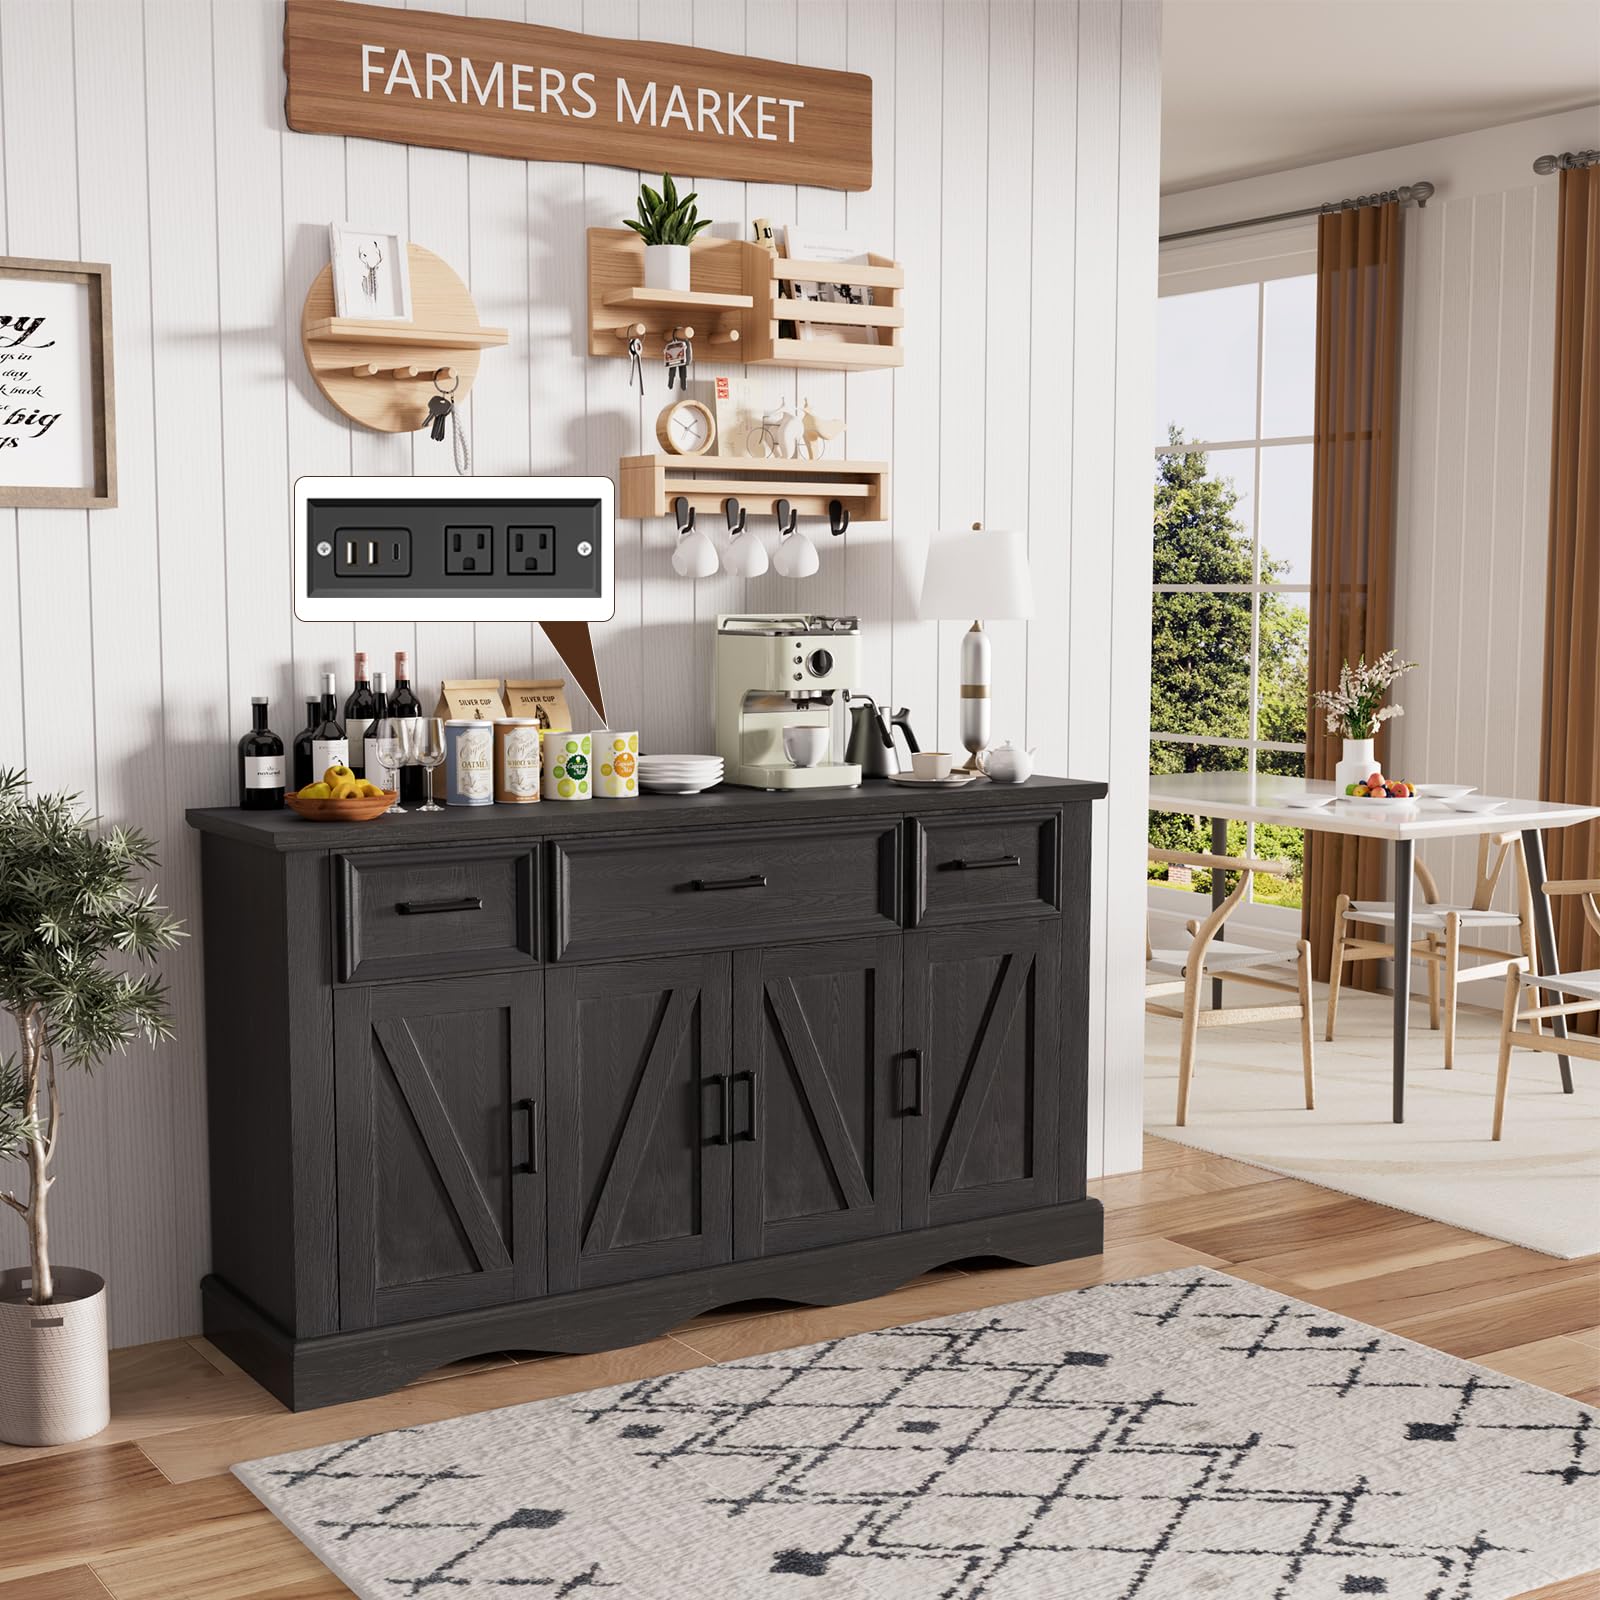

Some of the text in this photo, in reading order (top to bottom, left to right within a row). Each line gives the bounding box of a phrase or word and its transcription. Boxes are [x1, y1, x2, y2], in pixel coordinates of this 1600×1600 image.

[361, 44, 805, 143] FARMERS MARKET
[2, 370, 31, 381] day
[9, 386, 45, 398] back
[2, 408, 62, 438] big
